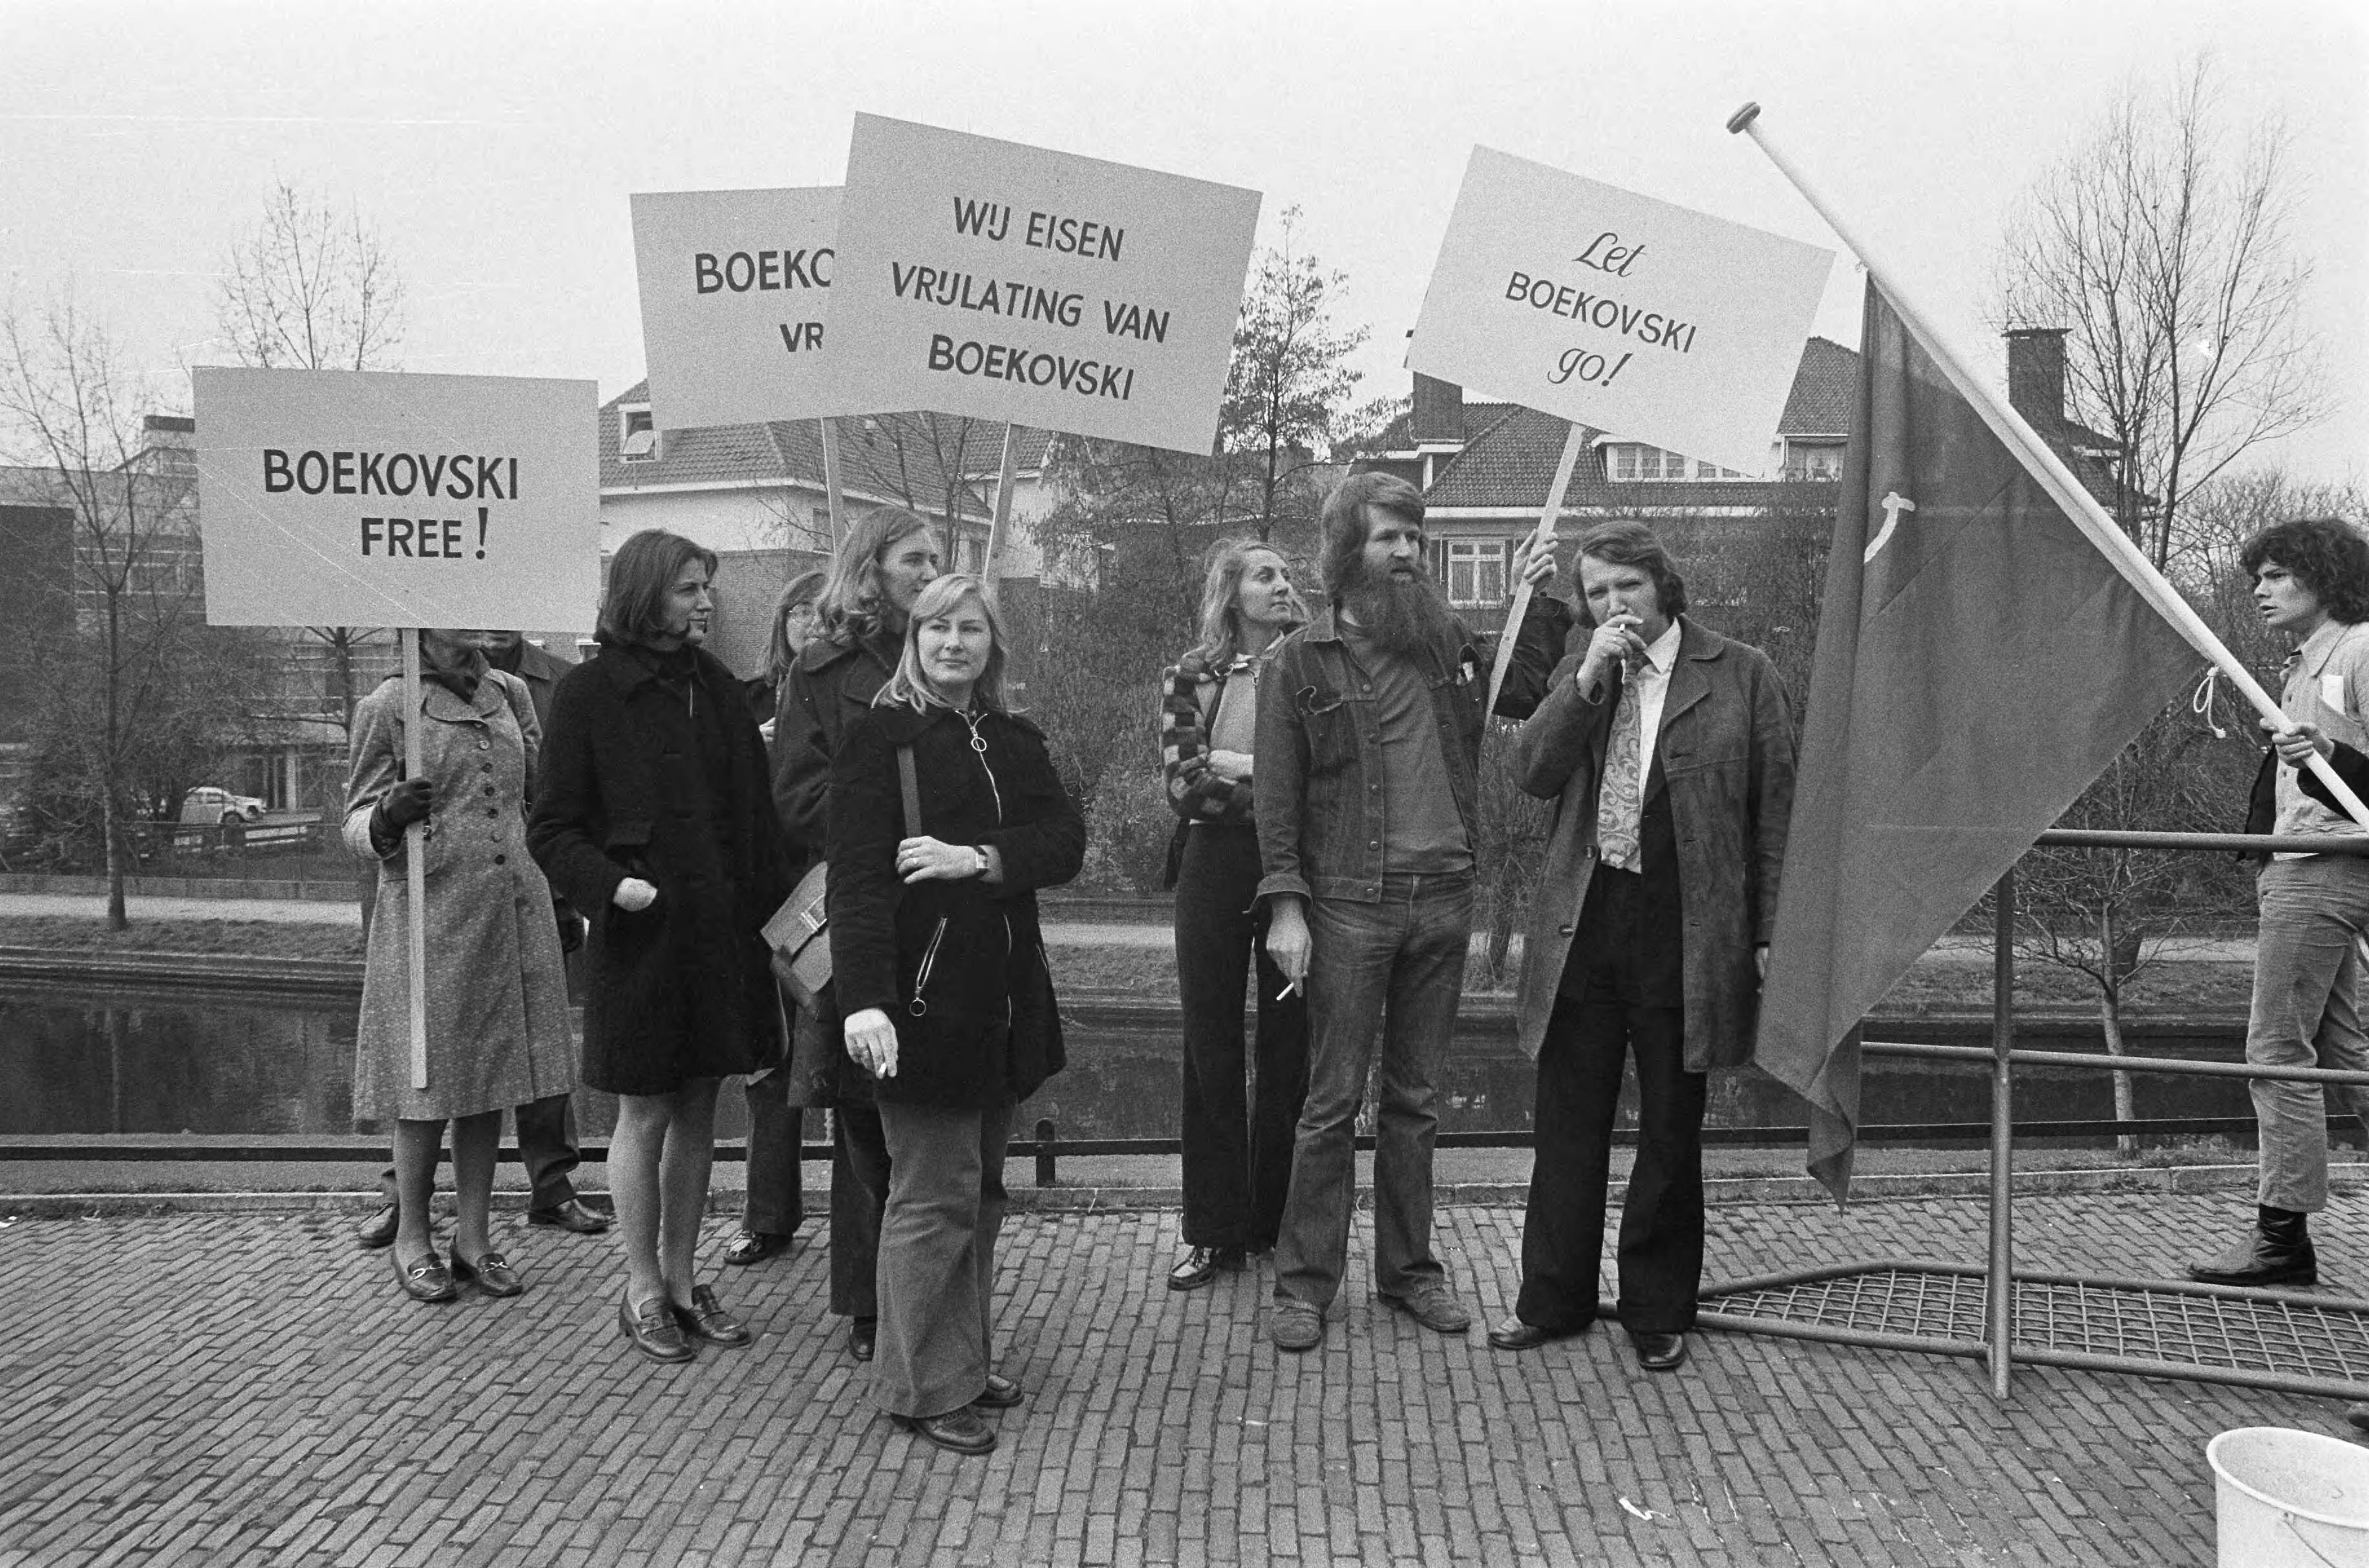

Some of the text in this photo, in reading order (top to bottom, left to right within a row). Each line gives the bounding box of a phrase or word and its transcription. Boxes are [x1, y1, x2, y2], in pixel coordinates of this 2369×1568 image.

[954, 196, 1124, 262] WIJ EISEN
[1572, 232, 1646, 277] Let
[892, 262, 1170, 343] VRIJLATING VAN
[1505, 271, 1696, 353] BOEKOVSKI
[928, 334, 1134, 400] BOEKOVSKI
[1547, 347, 1633, 387] go!
[264, 449, 517, 500] BOEKOVSKI
[361, 507, 489, 560] FREE!
